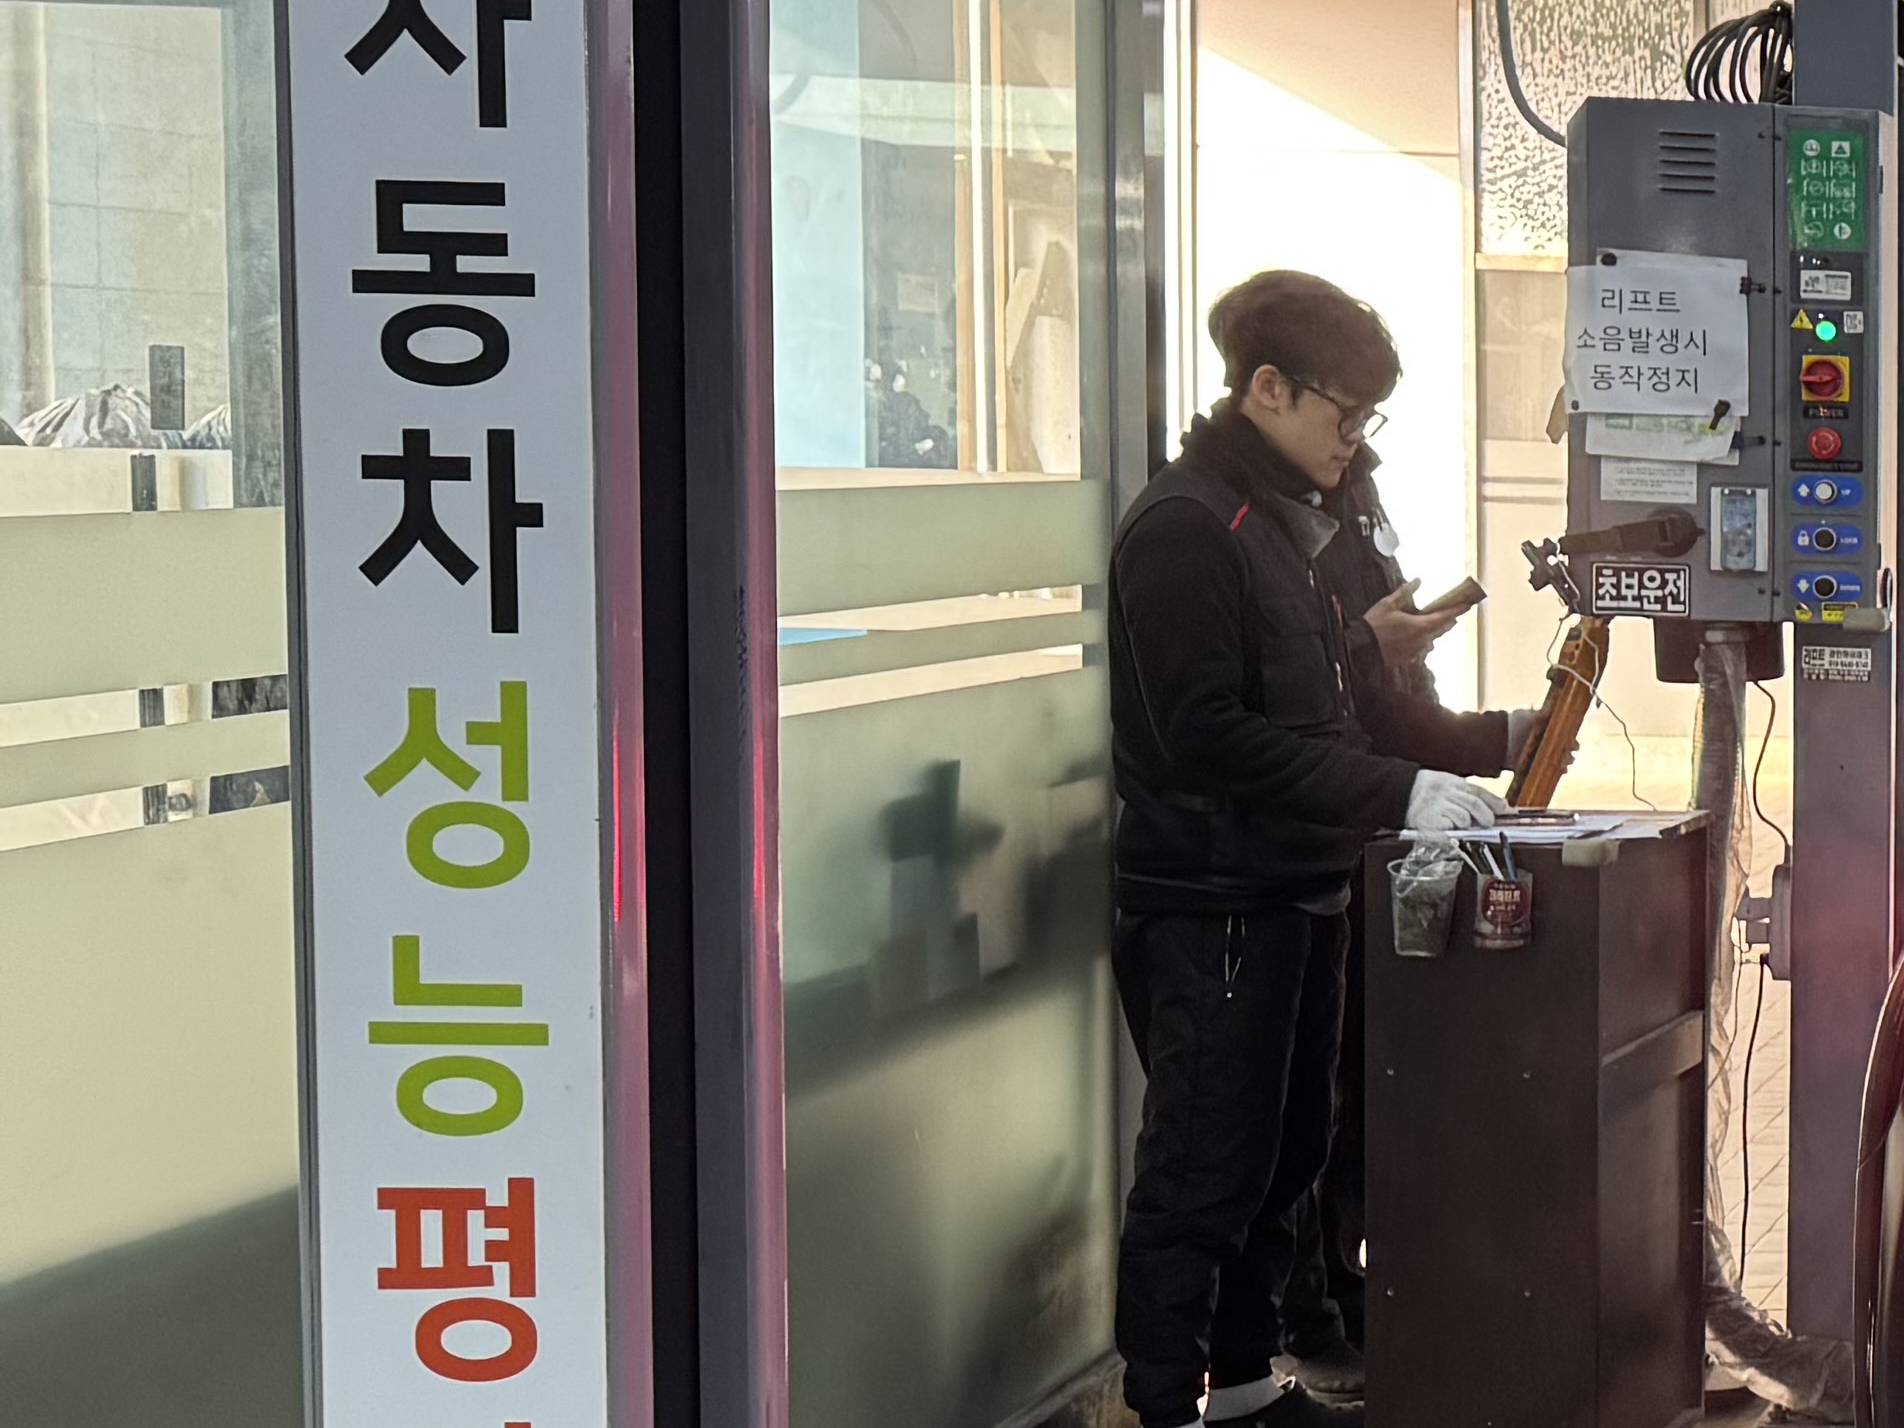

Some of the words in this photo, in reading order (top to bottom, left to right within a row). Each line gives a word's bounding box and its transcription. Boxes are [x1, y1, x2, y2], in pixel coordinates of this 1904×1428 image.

[1601, 288, 1681, 315] 리프트
[1576, 325, 1707, 356] 소음발생시
[1590, 364, 1699, 394] 동작정지
[1596, 568, 1685, 612] 초보운전
